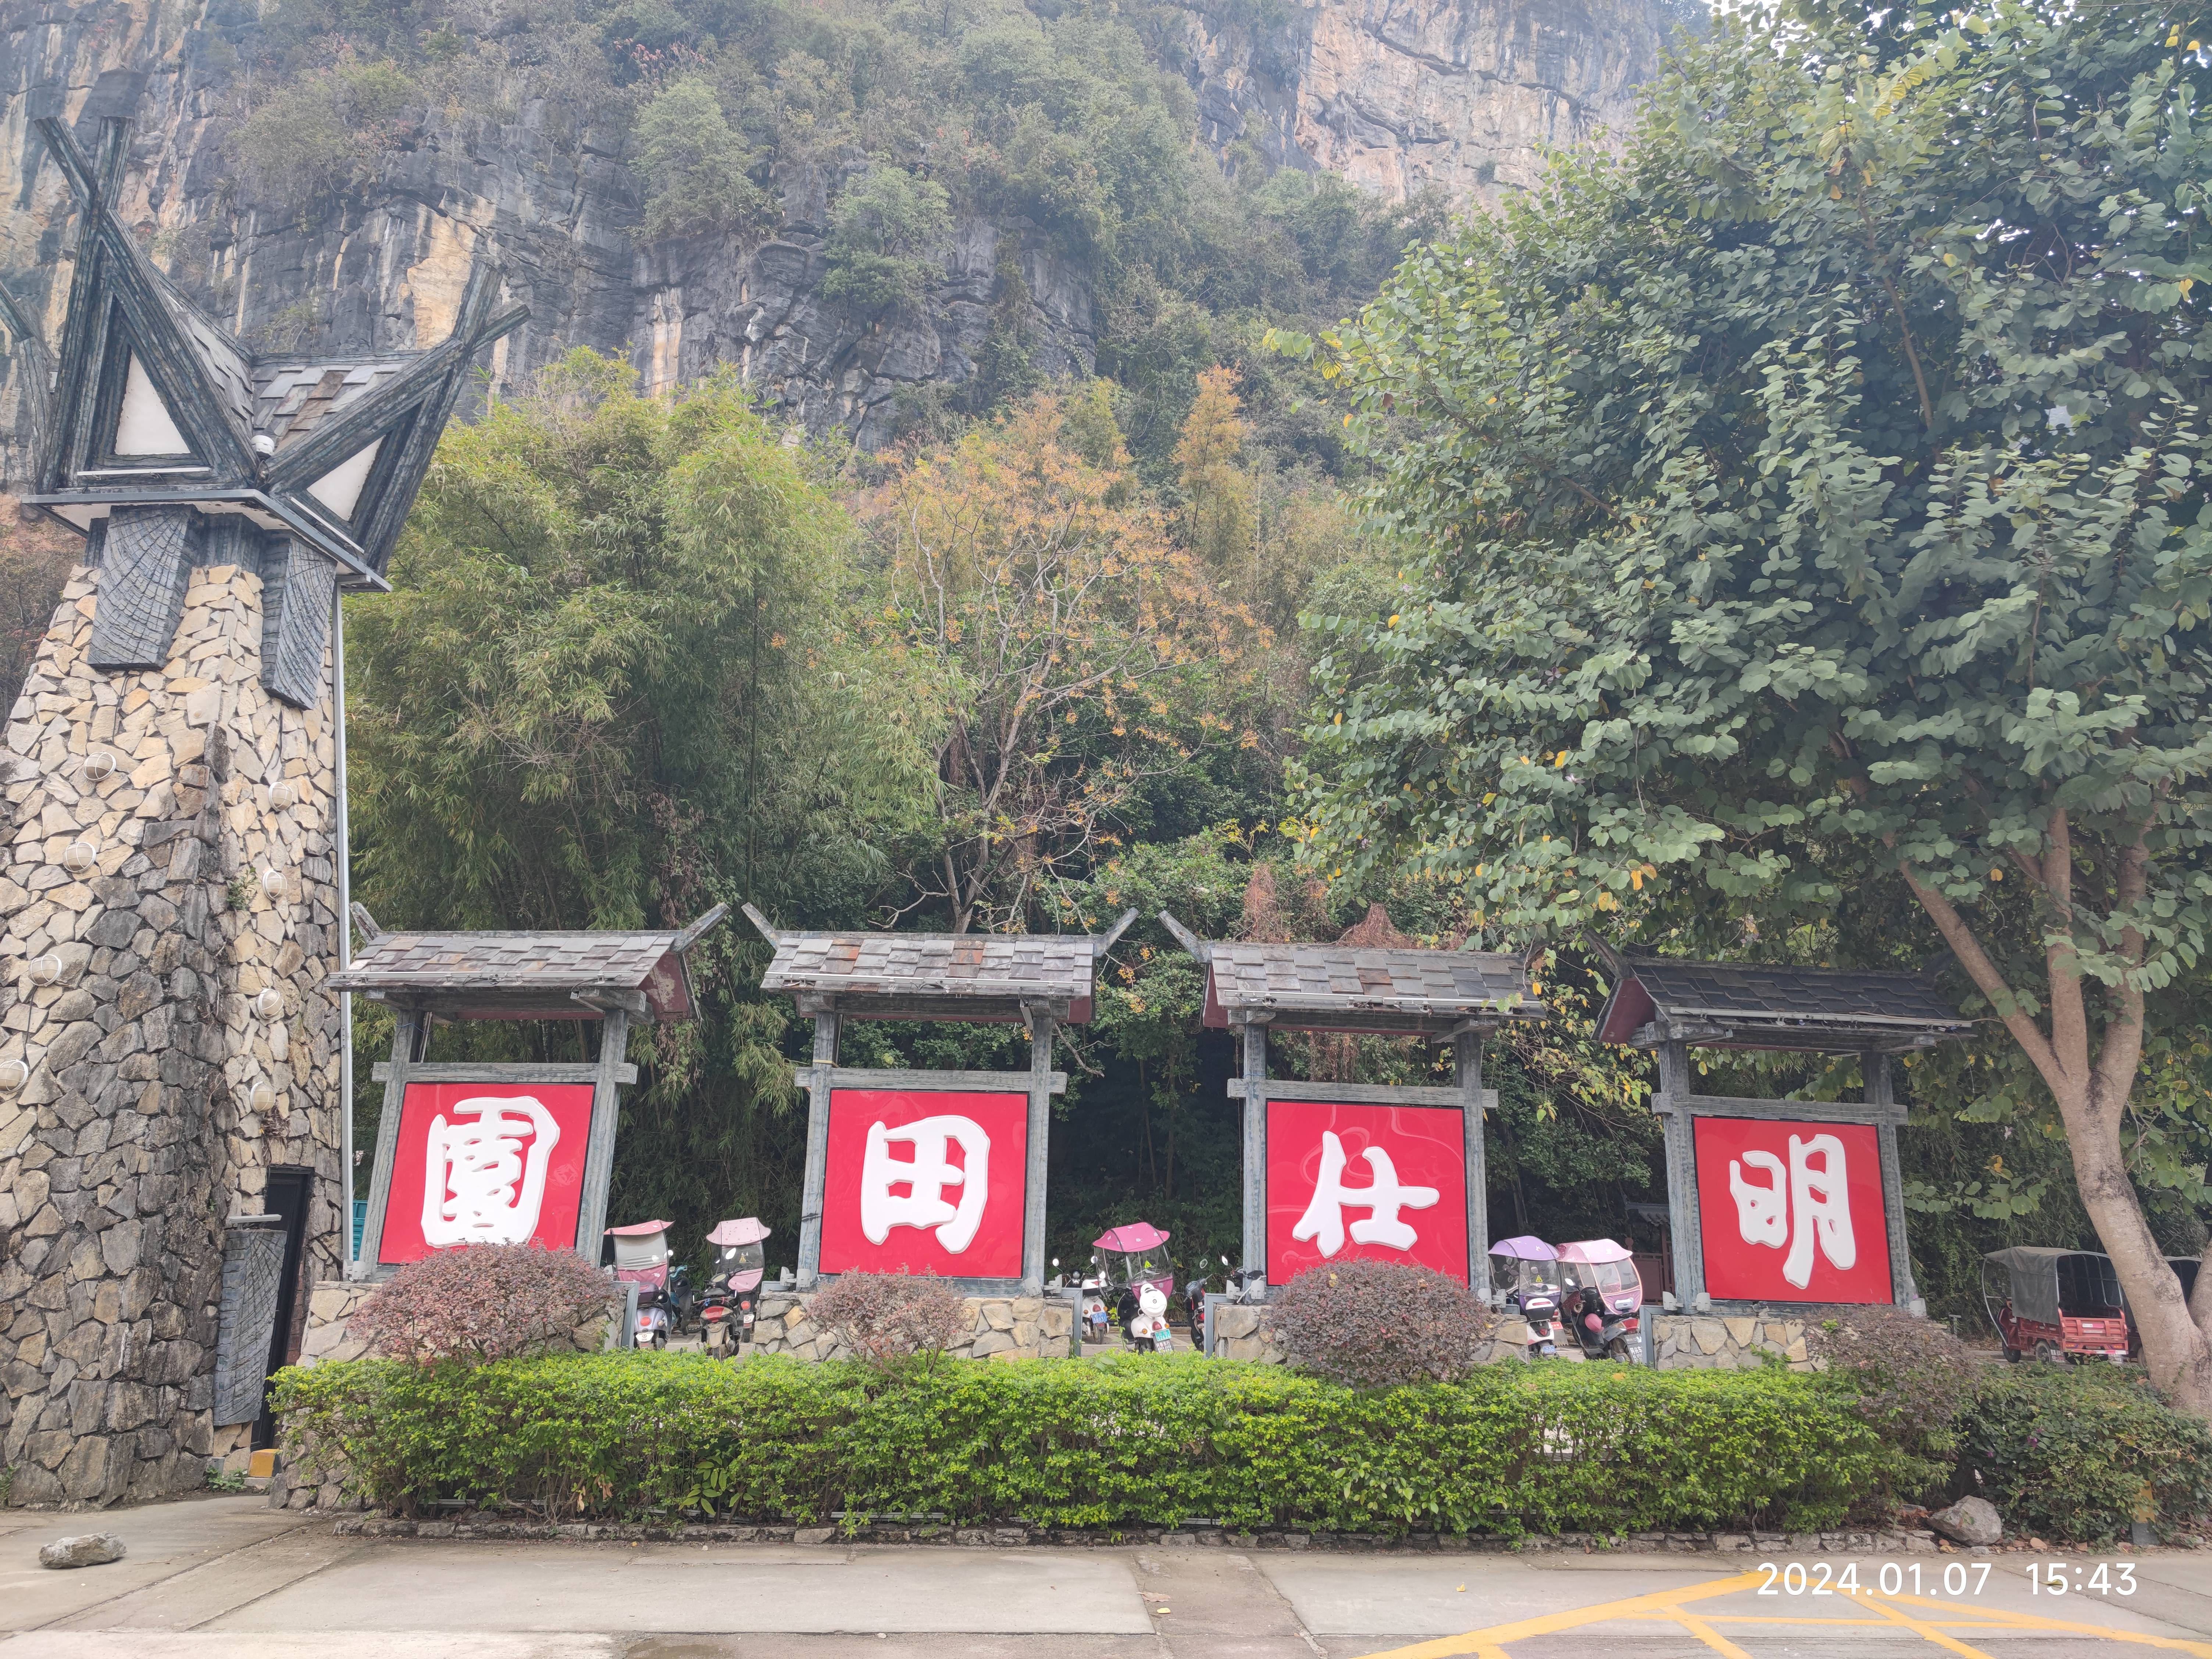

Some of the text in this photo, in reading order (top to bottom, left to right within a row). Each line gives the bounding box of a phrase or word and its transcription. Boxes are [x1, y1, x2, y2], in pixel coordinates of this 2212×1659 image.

[860, 1114, 991, 1254] 田
[1292, 1131, 1440, 1258] 仕
[1730, 1134, 1856, 1289] 明
